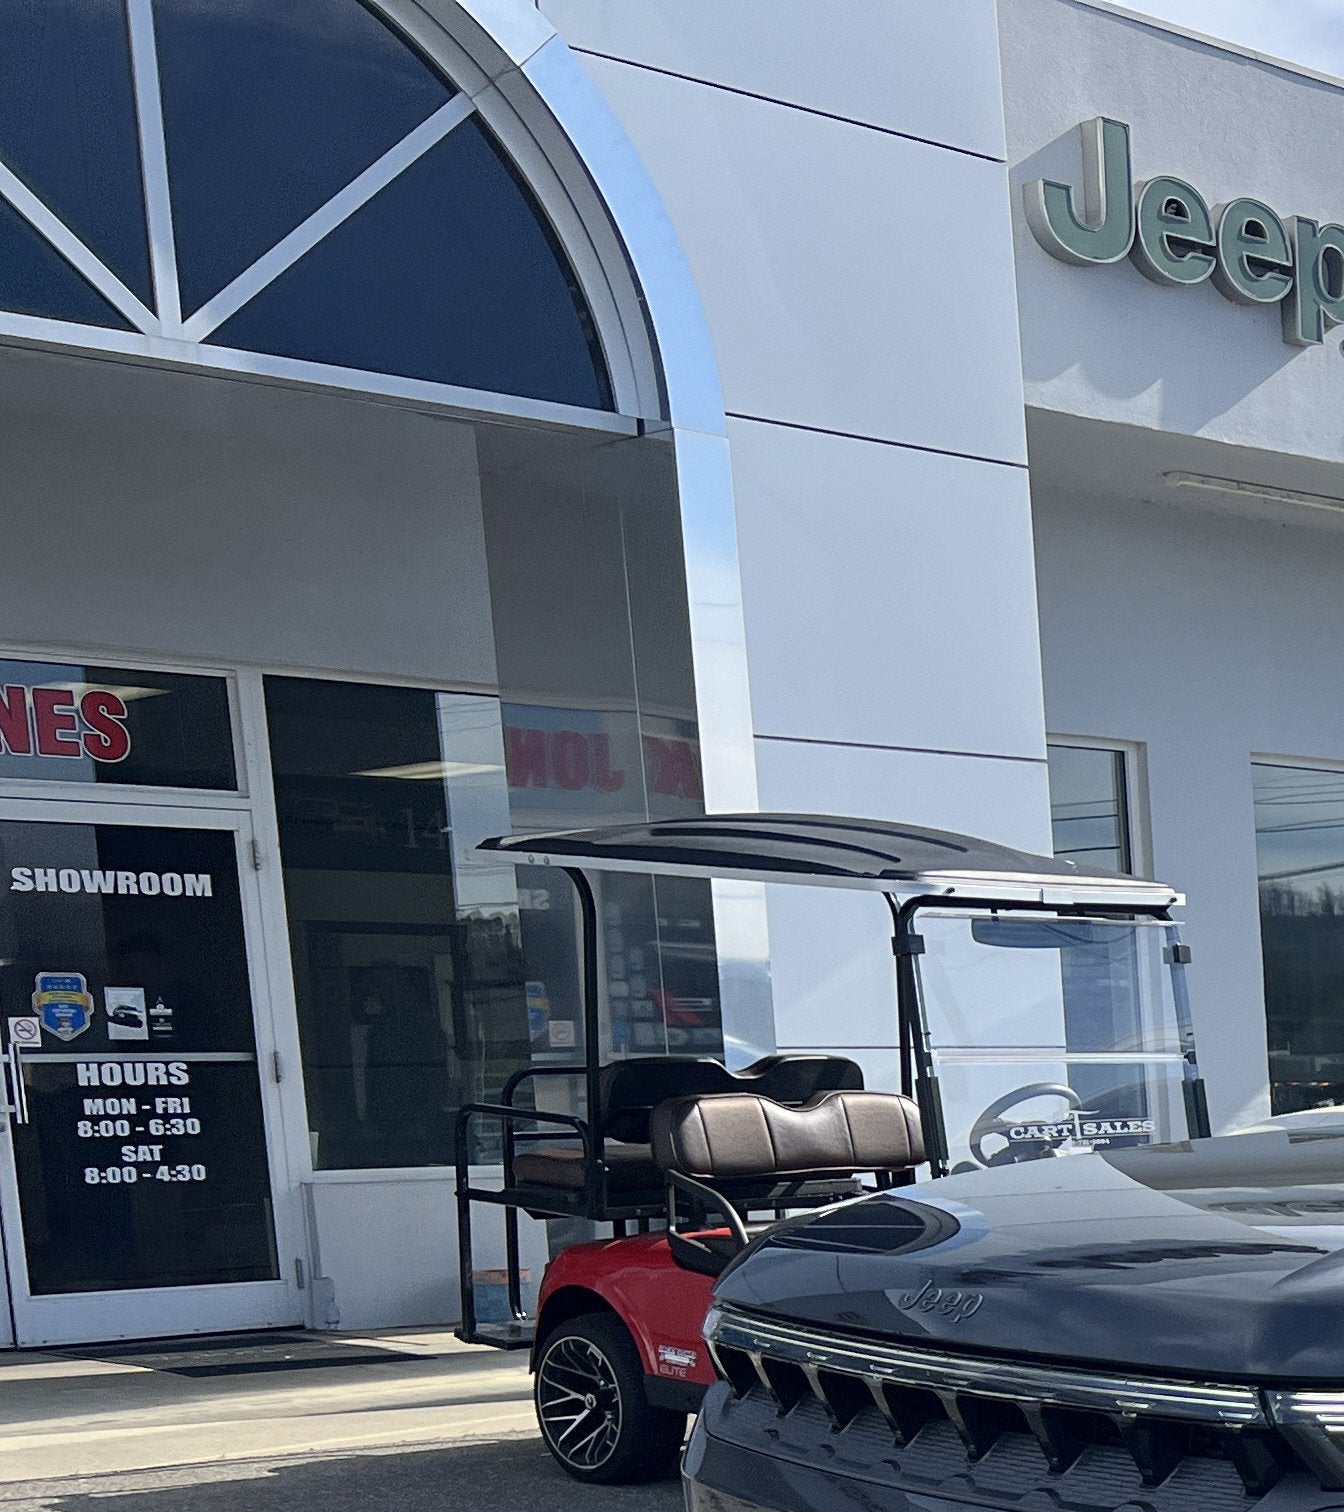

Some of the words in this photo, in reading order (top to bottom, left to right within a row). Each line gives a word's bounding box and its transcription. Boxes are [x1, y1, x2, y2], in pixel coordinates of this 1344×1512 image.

[10, 866, 213, 898] SHOWROOM
[76, 1062, 190, 1087] HOURS
[83, 1098, 137, 1116] MON
[154, 1097, 191, 1115] FRI
[77, 1120, 131, 1138] 8:00
[149, 1118, 201, 1136] 6:30
[1009, 1123, 1073, 1140] CART
[1083, 1120, 1156, 1136] SALES
[121, 1144, 164, 1162] SAT
[84, 1166, 138, 1184] 8:00
[155, 1164, 207, 1182] 4:30
[898, 1279, 984, 1324] Jeep
